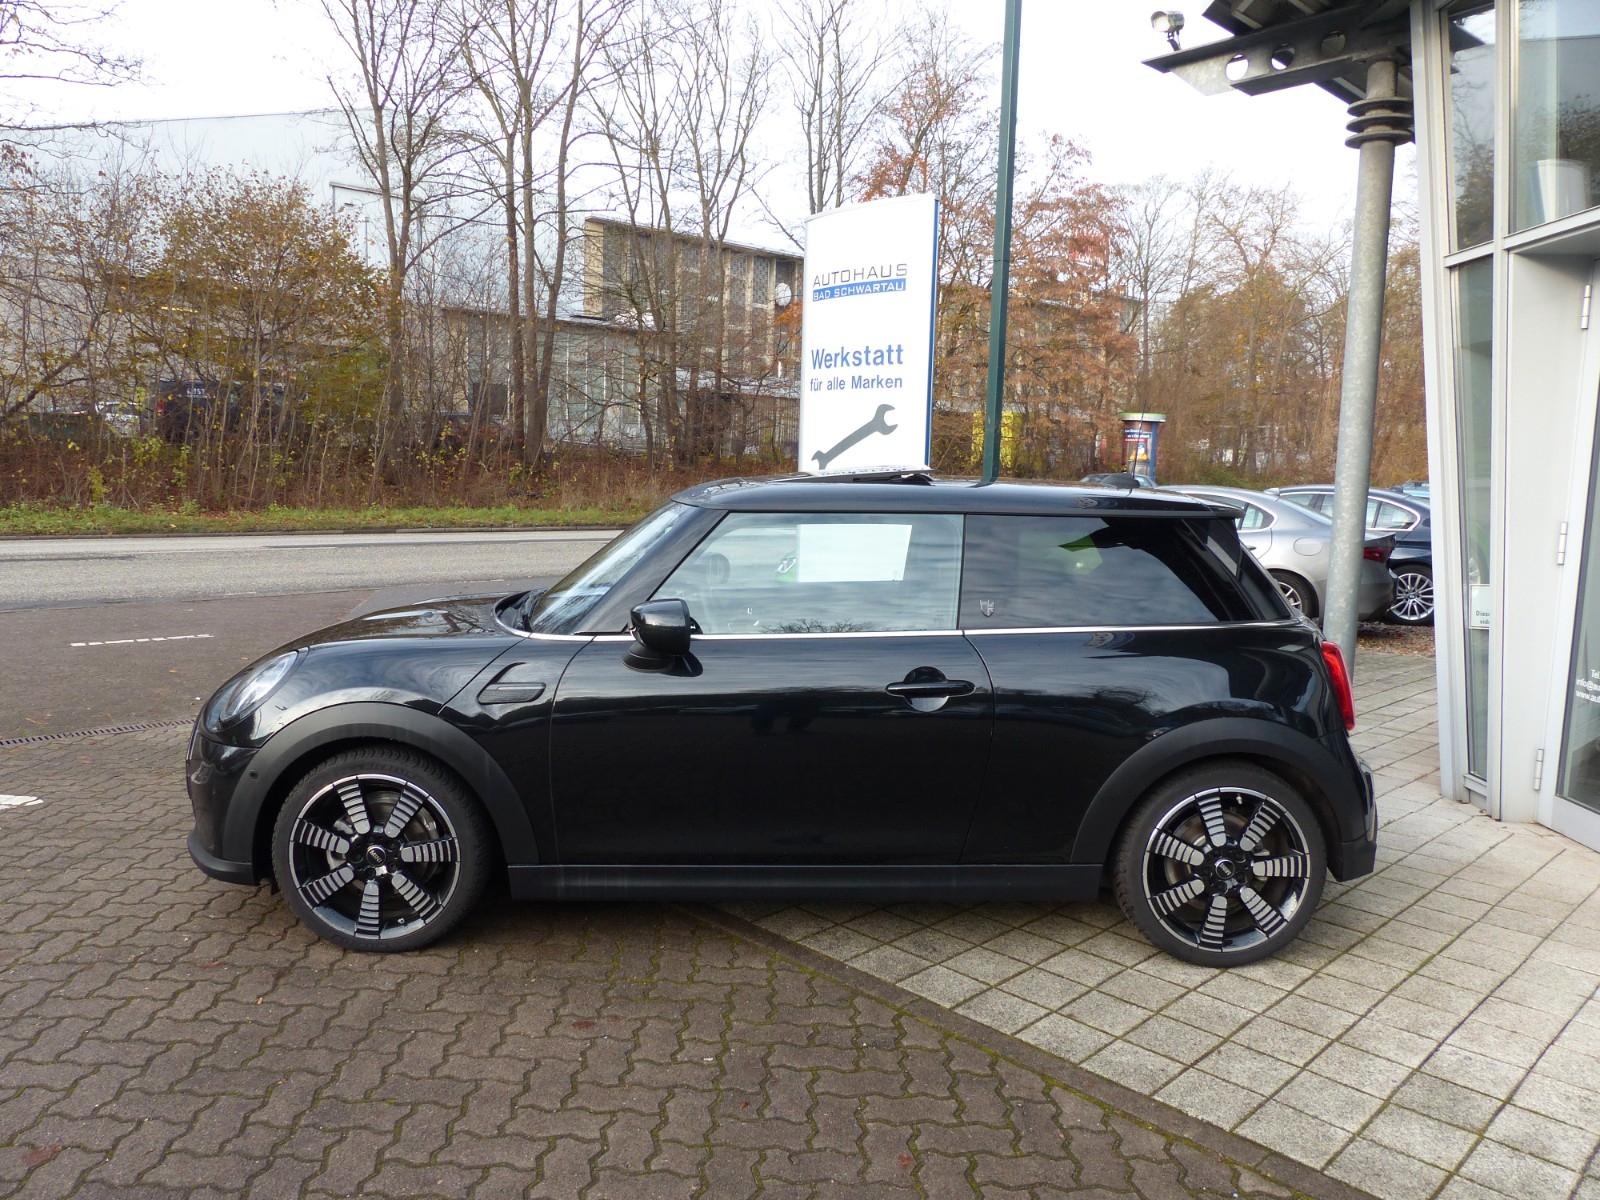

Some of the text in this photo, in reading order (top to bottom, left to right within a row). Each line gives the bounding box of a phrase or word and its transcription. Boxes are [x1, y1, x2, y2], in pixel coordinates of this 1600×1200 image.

[812, 263, 908, 288] AUTOHAUS
[813, 281, 905, 301] BAD SCHWARTAU
[811, 343, 904, 370] Werkstatt
[810, 374, 903, 392] für alle Marken
